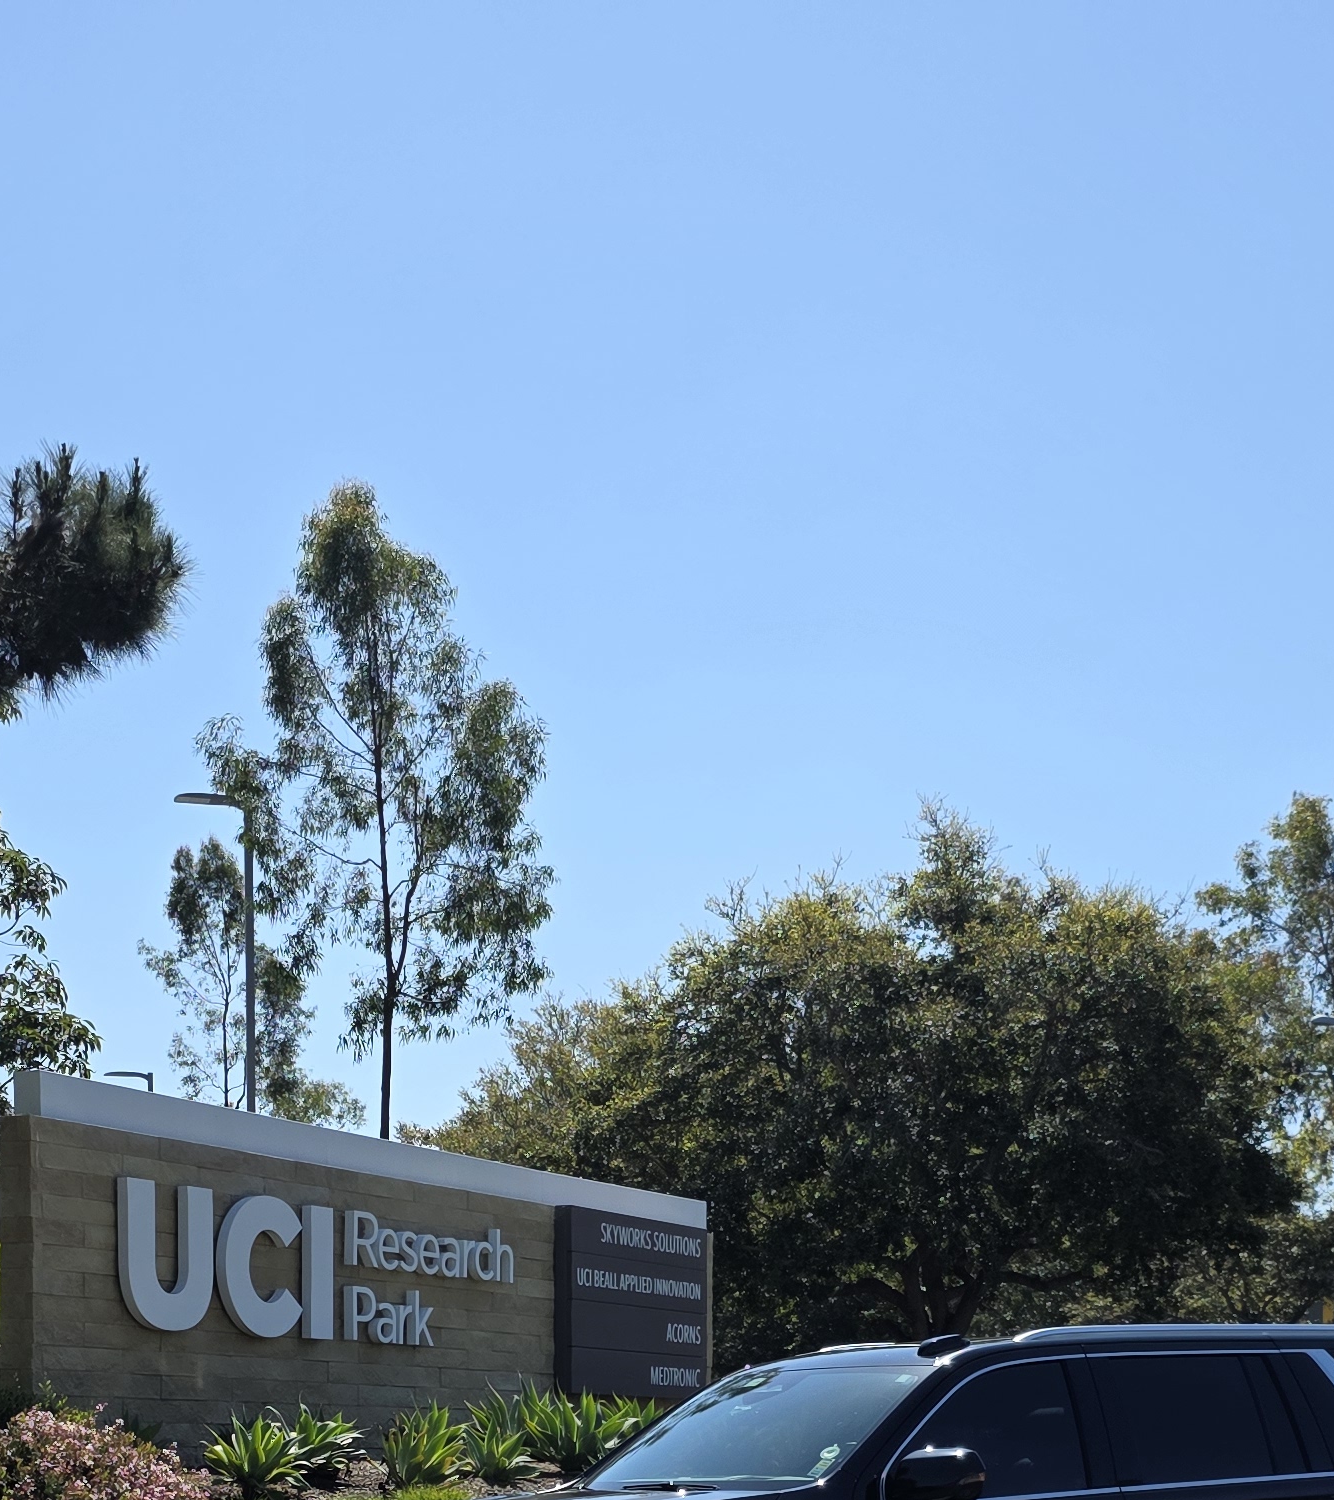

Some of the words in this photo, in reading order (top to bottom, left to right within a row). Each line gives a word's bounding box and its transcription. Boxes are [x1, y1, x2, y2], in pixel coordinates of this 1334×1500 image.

[117, 1176, 333, 1340] UCI
[344, 1210, 514, 1284] Research
[600, 1222, 652, 1250] SKYWORKS
[653, 1231, 701, 1258] SOLUTIONS
[577, 1267, 593, 1286] UCI
[594, 1270, 618, 1290] BEALL
[619, 1273, 653, 1294] APPLIED
[653, 1278, 701, 1301] INNOVATION
[344, 1285, 435, 1347] Park
[666, 1322, 701, 1345] ACORNS
[650, 1365, 701, 1388] MEDTRONIC
